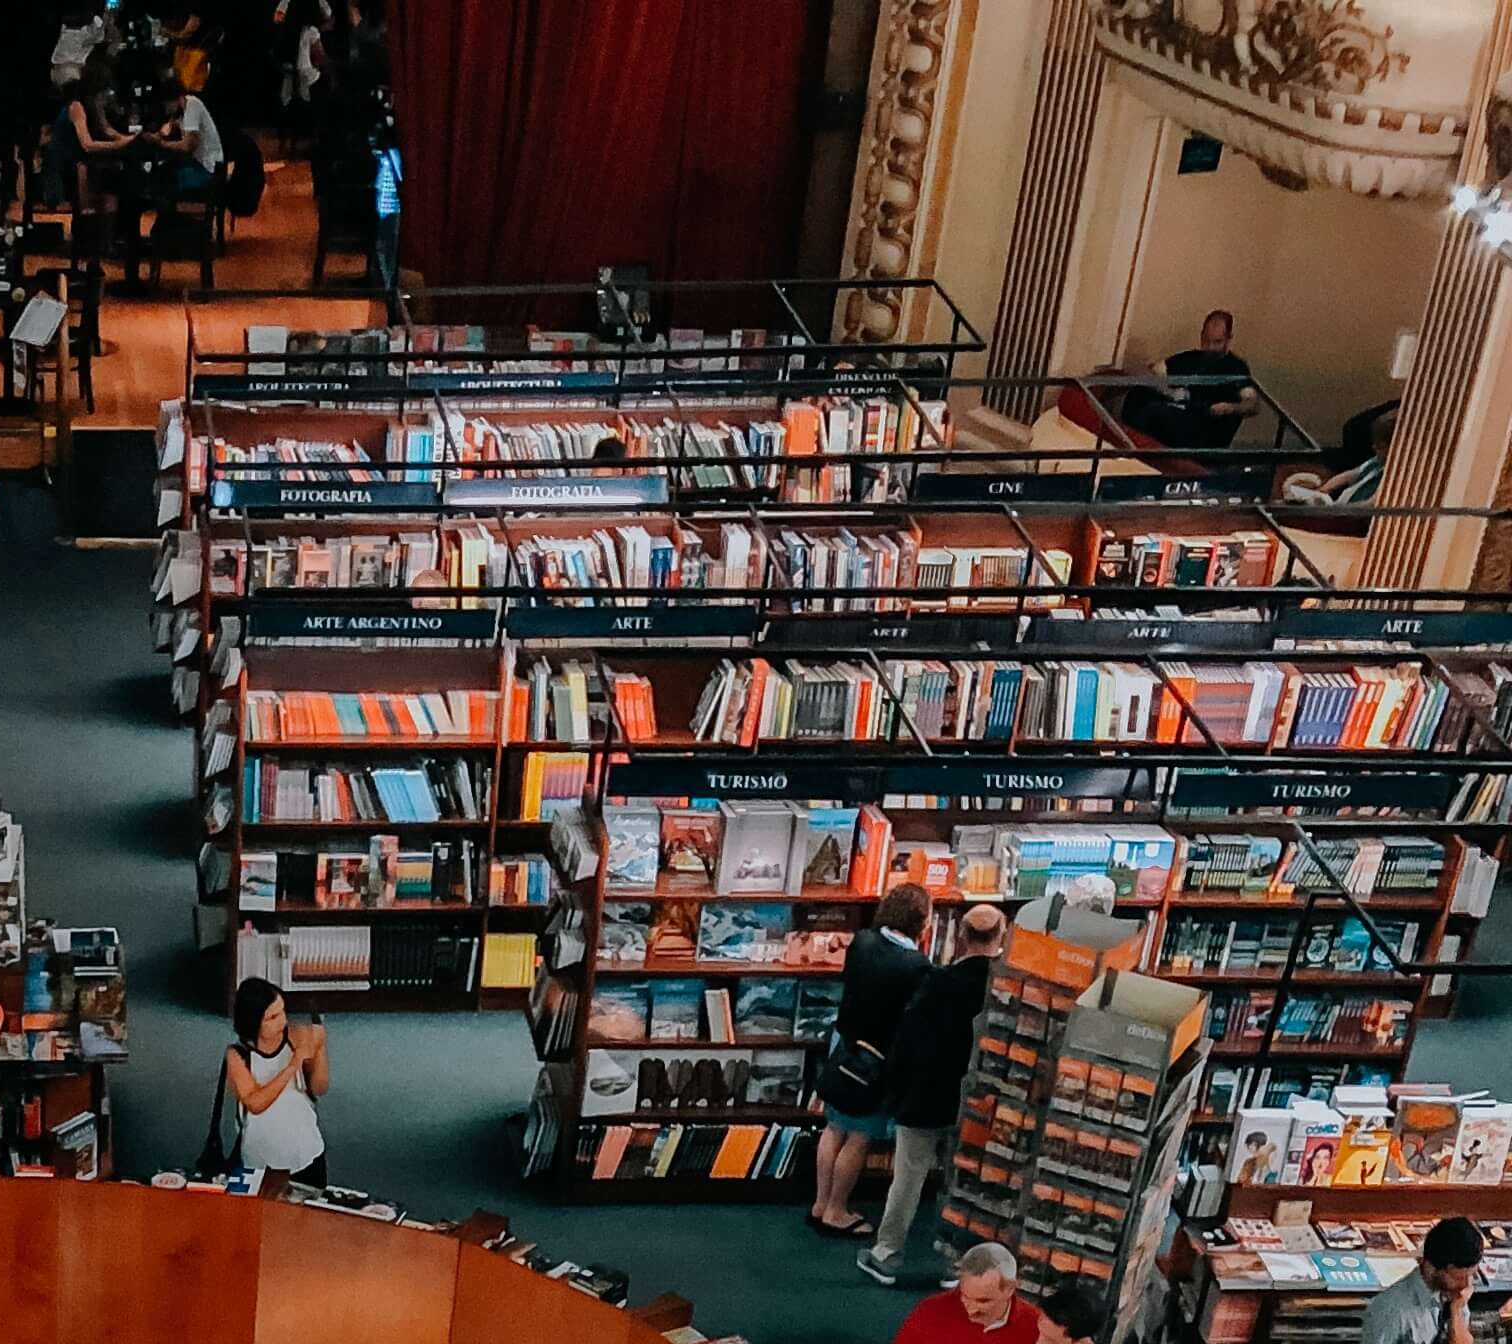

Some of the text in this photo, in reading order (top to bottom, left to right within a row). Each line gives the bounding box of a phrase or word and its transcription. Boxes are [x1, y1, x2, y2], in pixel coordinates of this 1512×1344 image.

[511, 485, 603, 500] FOTOGRAFIA
[988, 481, 1024, 495] CINE
[1164, 481, 1203, 494] CINE
[280, 488, 373, 504] FOTOGRAFIA
[302, 615, 443, 631] ARTE ARGENTINO
[611, 615, 654, 631] ARTE
[1380, 619, 1424, 635] ARTE
[869, 627, 911, 639] ARTE
[1128, 626, 1172, 640] ARTE
[706, 773, 788, 790] TURISMO
[983, 772, 1064, 790] TURISMO
[1271, 783, 1352, 799] TURISMO
